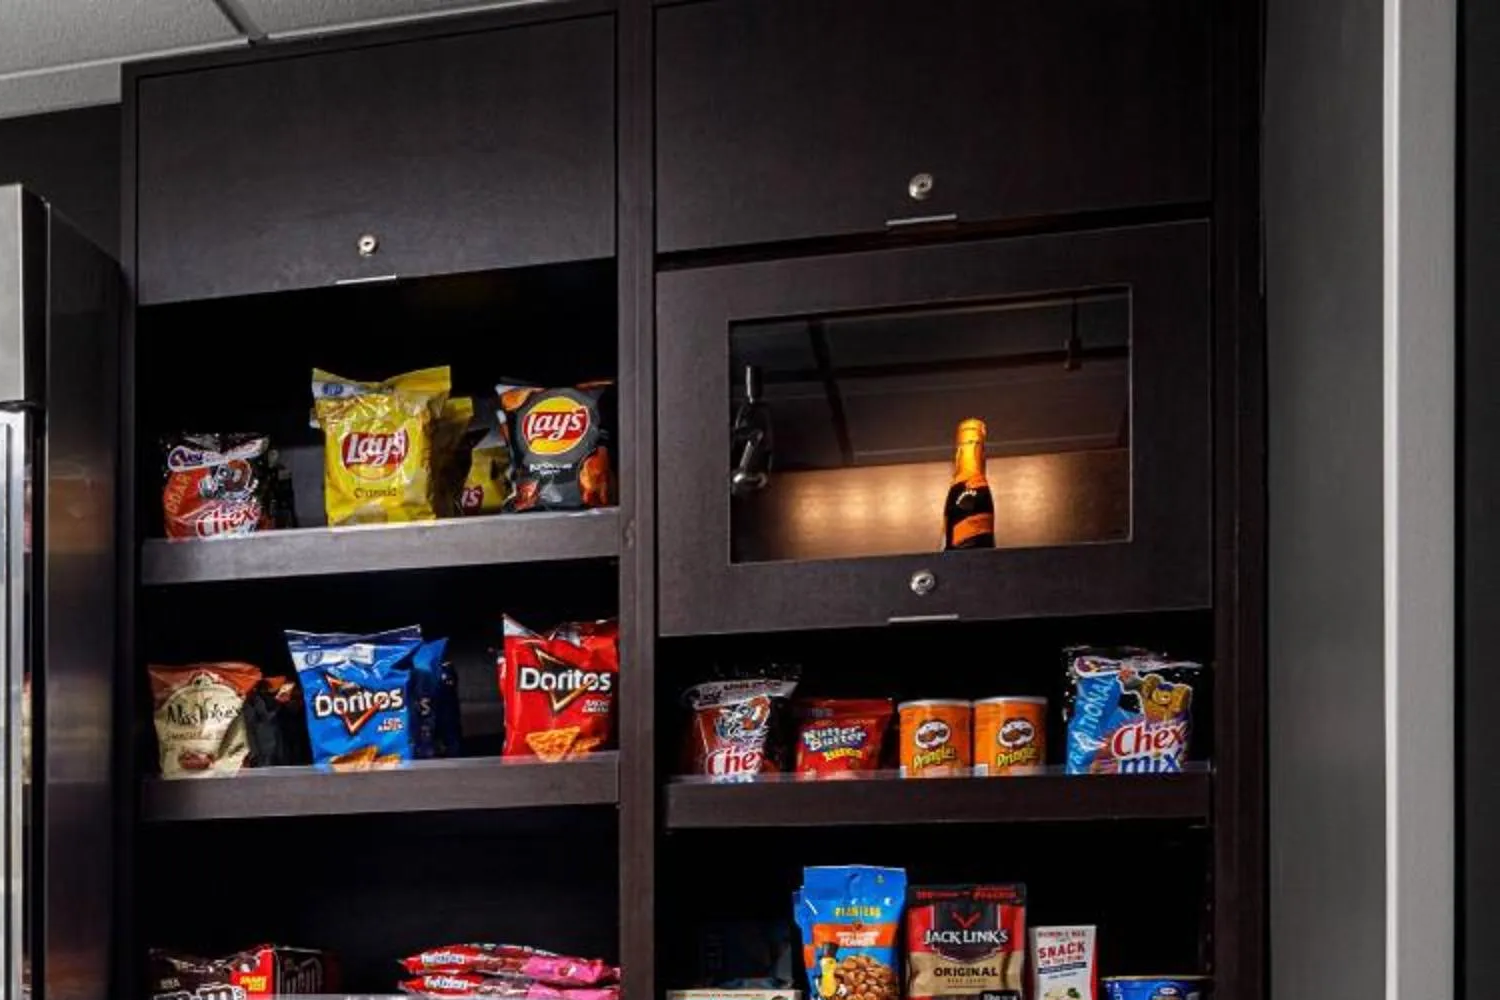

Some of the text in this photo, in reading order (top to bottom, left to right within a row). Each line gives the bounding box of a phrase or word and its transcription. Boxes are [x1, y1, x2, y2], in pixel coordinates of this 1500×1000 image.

[527, 406, 586, 441] Lay's
[346, 428, 406, 467] Lay's
[519, 666, 612, 691] Doritos
[314, 688, 404, 718] Doritos
[1112, 723, 1188, 758] Chex
[924, 929, 962, 945] JACK
[1037, 941, 1086, 959] SNACK
[933, 966, 998, 977] ORIGINAL
